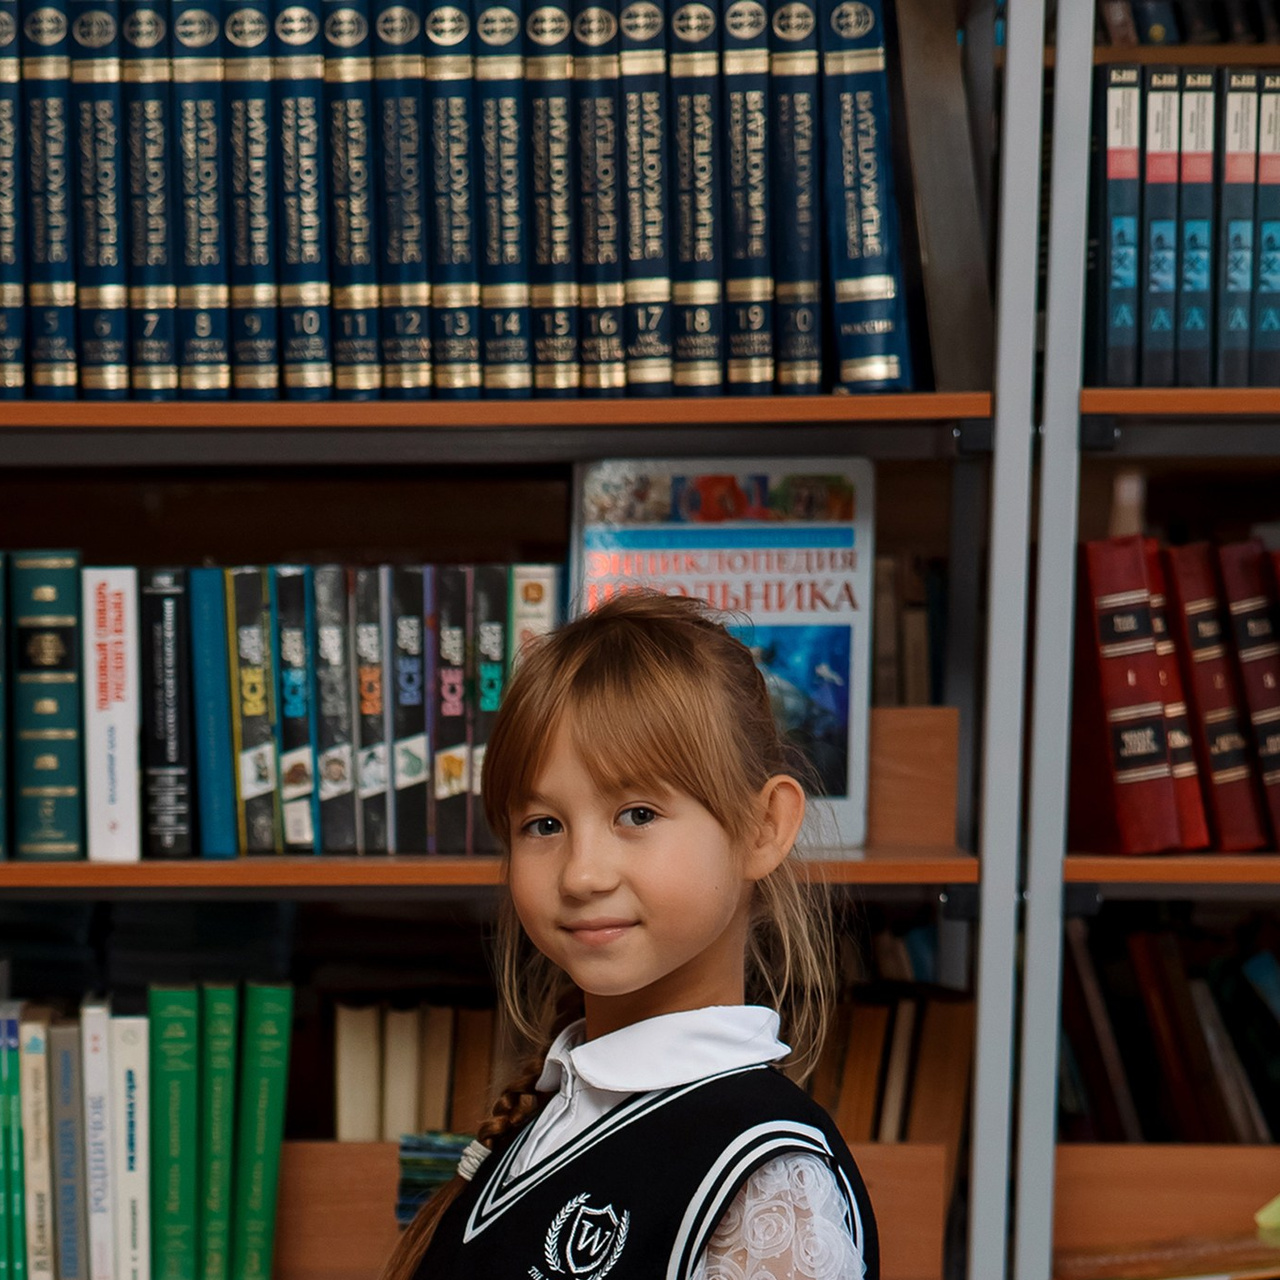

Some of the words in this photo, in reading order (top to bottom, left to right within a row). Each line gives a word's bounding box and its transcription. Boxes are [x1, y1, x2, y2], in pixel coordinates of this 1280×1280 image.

[45, 97, 67, 264] ЭНЦИКЛОПЕДИЯ
[95, 100, 118, 266] ЭНЦИКЛОПЕДИЯ
[144, 99, 167, 266] ЭНЦИКЛОПЕДИЯ
[197, 100, 220, 266] ЭНЦИКЛОПЕДИЯ
[247, 98, 269, 265] ЭНЦИКЛОПЕДИЯ
[297, 97, 320, 264] ЭНЦИКЛОПЕДИЯ
[347, 99, 370, 265] ЭНЦИКЛОПЕДИЯ
[399, 97, 422, 265] ЭНЦИКЛОПЕДИЯ
[448, 97, 470, 264] ЭНЦИКЛОПЕДИЯ
[499, 97, 520, 264] ЭНЦИКЛОПЕДИЯ
[549, 97, 571, 264] ЭНЦИКЛОПЕДИЯ
[595, 97, 617, 264] ЭНЦИКЛОПЕДИЯ
[641, 92, 664, 259] ЭНЦИКЛОПЕДИЯ
[693, 94, 714, 261] ЭНЦИКЛОПЕДИЯ
[745, 91, 767, 258] ЭНЦИКЛОПЕДИЯ
[856, 91, 882, 258] ЭНЦИКЛОПЕДИЯ
[45, 311, 59, 333] 5
[94, 312, 112, 337] 6
[143, 313, 160, 337] 7
[195, 312, 211, 337] 8
[244, 313, 262, 336] 9
[292, 310, 319, 335] 10
[342, 314, 367, 336] 11
[394, 311, 420, 335] 12
[441, 311, 470, 336] 13
[493, 311, 520, 336] 14
[543, 311, 569, 336] 15
[589, 311, 618, 336] 16
[636, 306, 663, 330] 17
[684, 308, 710, 332] 18
[737, 305, 764, 330] 19
[586, 551, 858, 577] ЭНЦИКЛОПЕДИЯ
[91, 1095, 108, 1214] РОДНИЧОК
[577, 1219, 612, 1256] W
